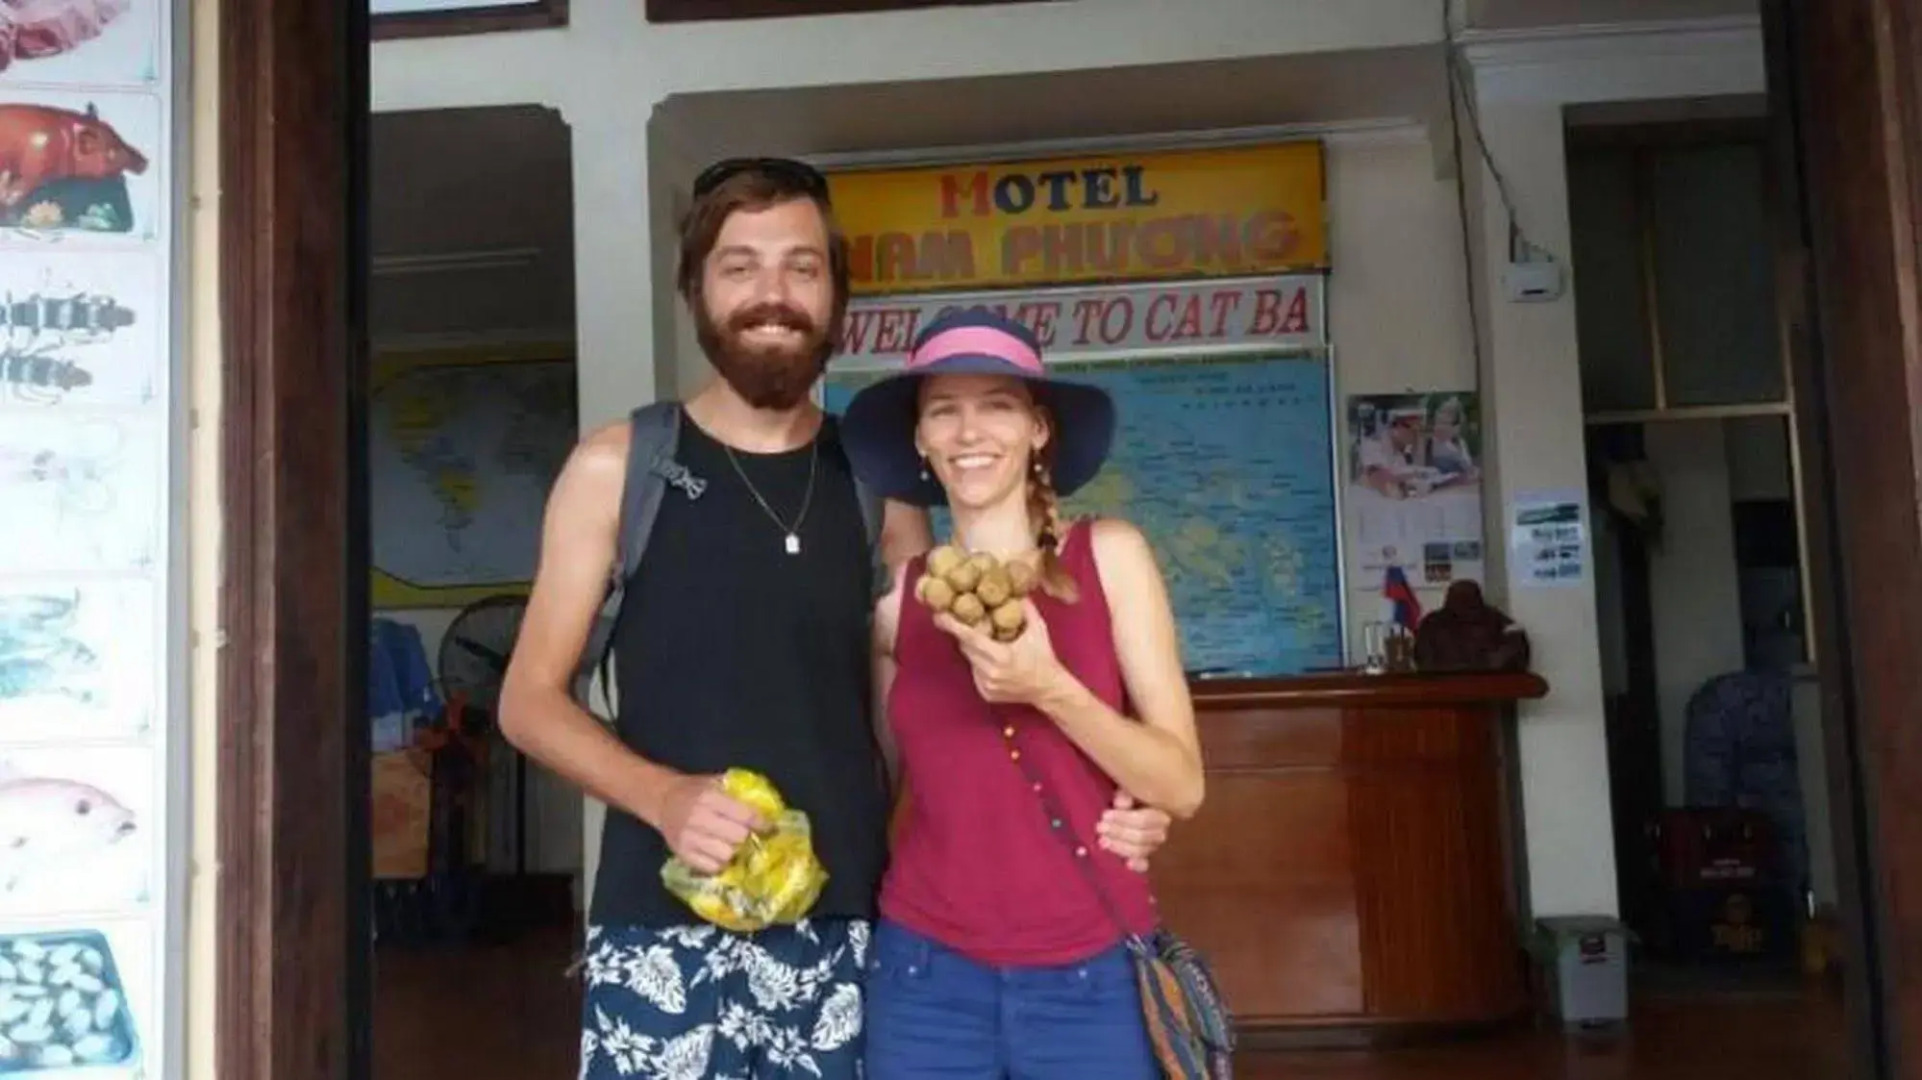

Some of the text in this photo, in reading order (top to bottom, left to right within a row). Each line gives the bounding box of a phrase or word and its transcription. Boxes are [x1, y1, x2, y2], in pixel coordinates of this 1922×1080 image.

[941, 165, 1159, 219] MOTEL
[841, 286, 1310, 355] WELE TO CAT BA
